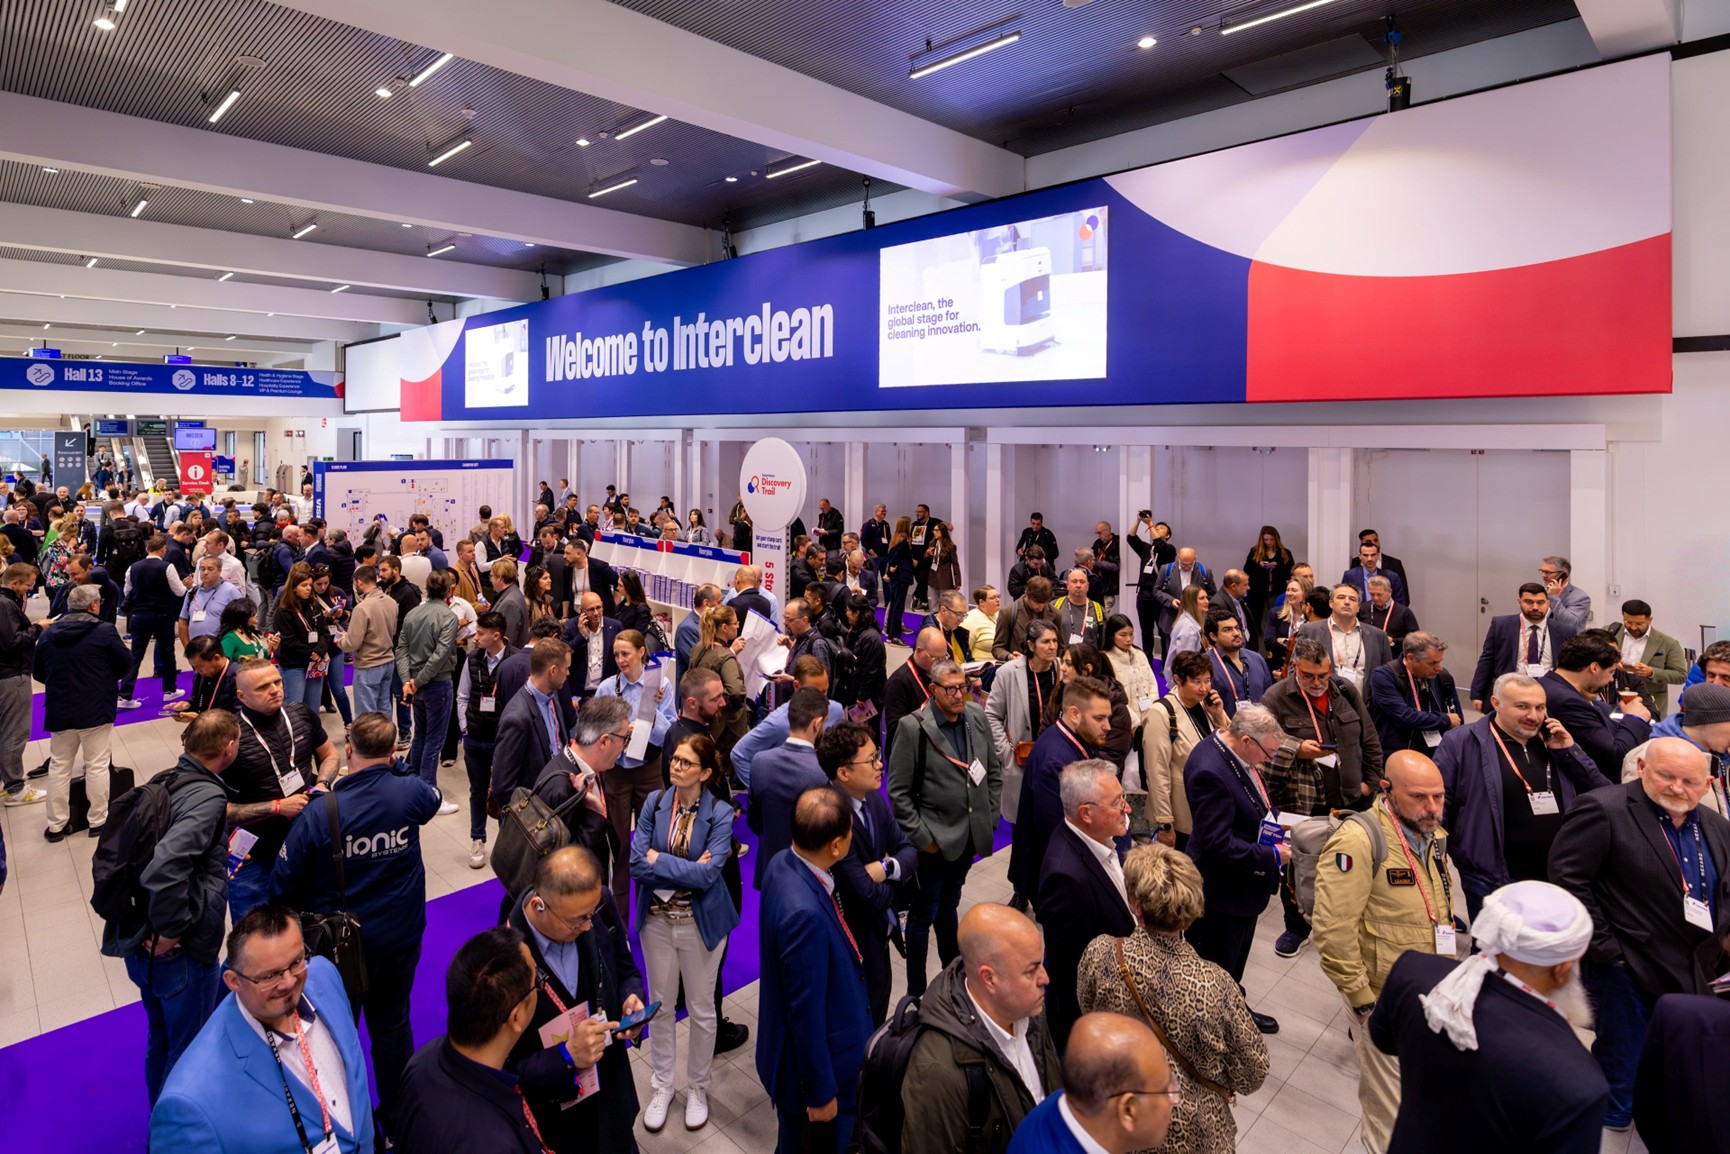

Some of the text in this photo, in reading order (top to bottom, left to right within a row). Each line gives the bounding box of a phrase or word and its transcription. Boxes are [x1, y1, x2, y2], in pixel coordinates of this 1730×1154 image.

[887, 297, 954, 315] Interclean, the
[887, 310, 960, 330] global stage for
[887, 321, 981, 340] cleaning innovation.
[545, 331, 637, 383] Welcome
[642, 321, 668, 373] to
[673, 302, 834, 371] Interclean
[64, 367, 103, 382] Hall 13
[203, 373, 228, 386] Halls
[761, 477, 792, 490] Discovery
[761, 486, 776, 495] Trail
[764, 561, 774, 593] 5 Sto
[345, 825, 410, 859] ionic
[266, 1030, 281, 1063] NEXARO
